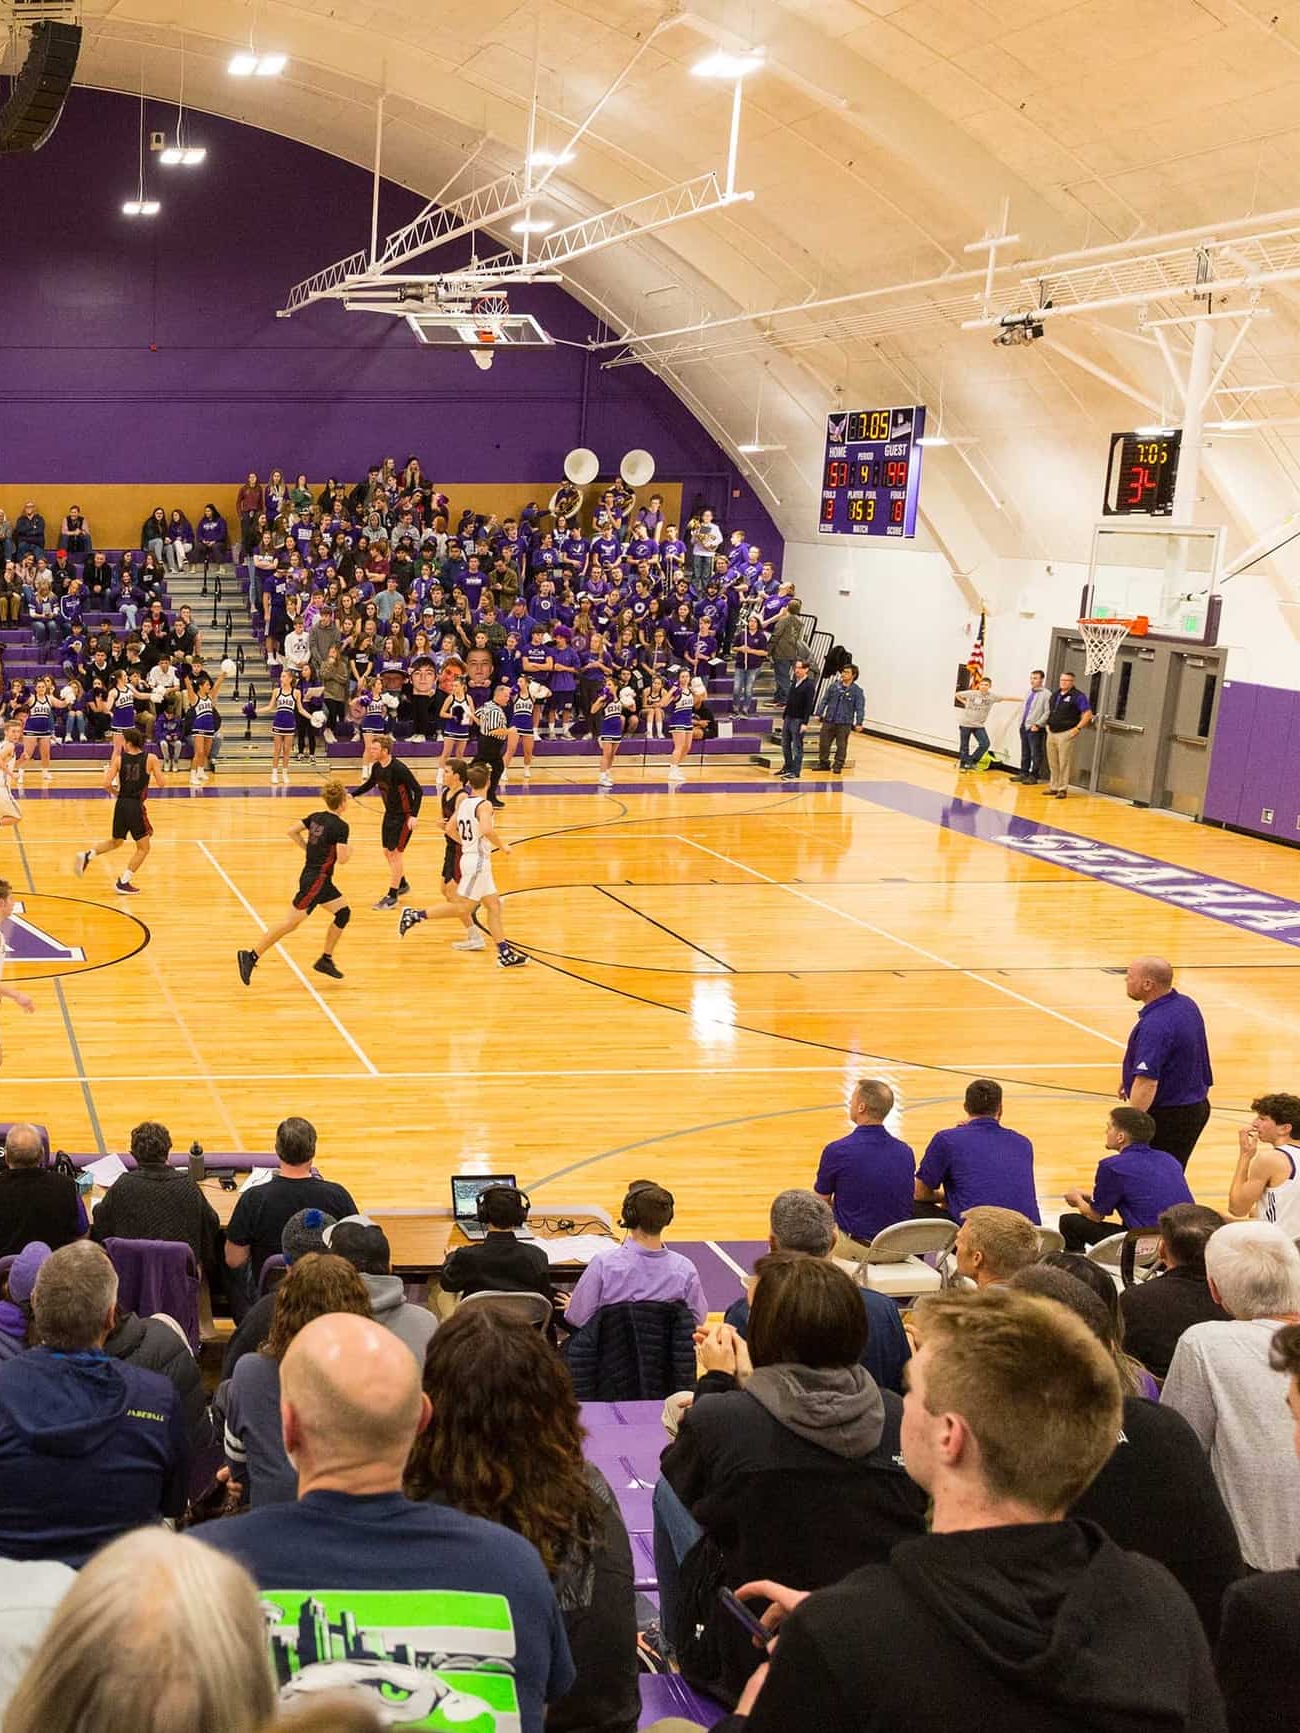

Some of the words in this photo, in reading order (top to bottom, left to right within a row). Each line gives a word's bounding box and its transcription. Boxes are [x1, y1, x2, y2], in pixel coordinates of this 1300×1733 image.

[829, 446, 847, 458] HOME
[884, 444, 908, 457] GUEST
[458, 819, 473, 841] 23
